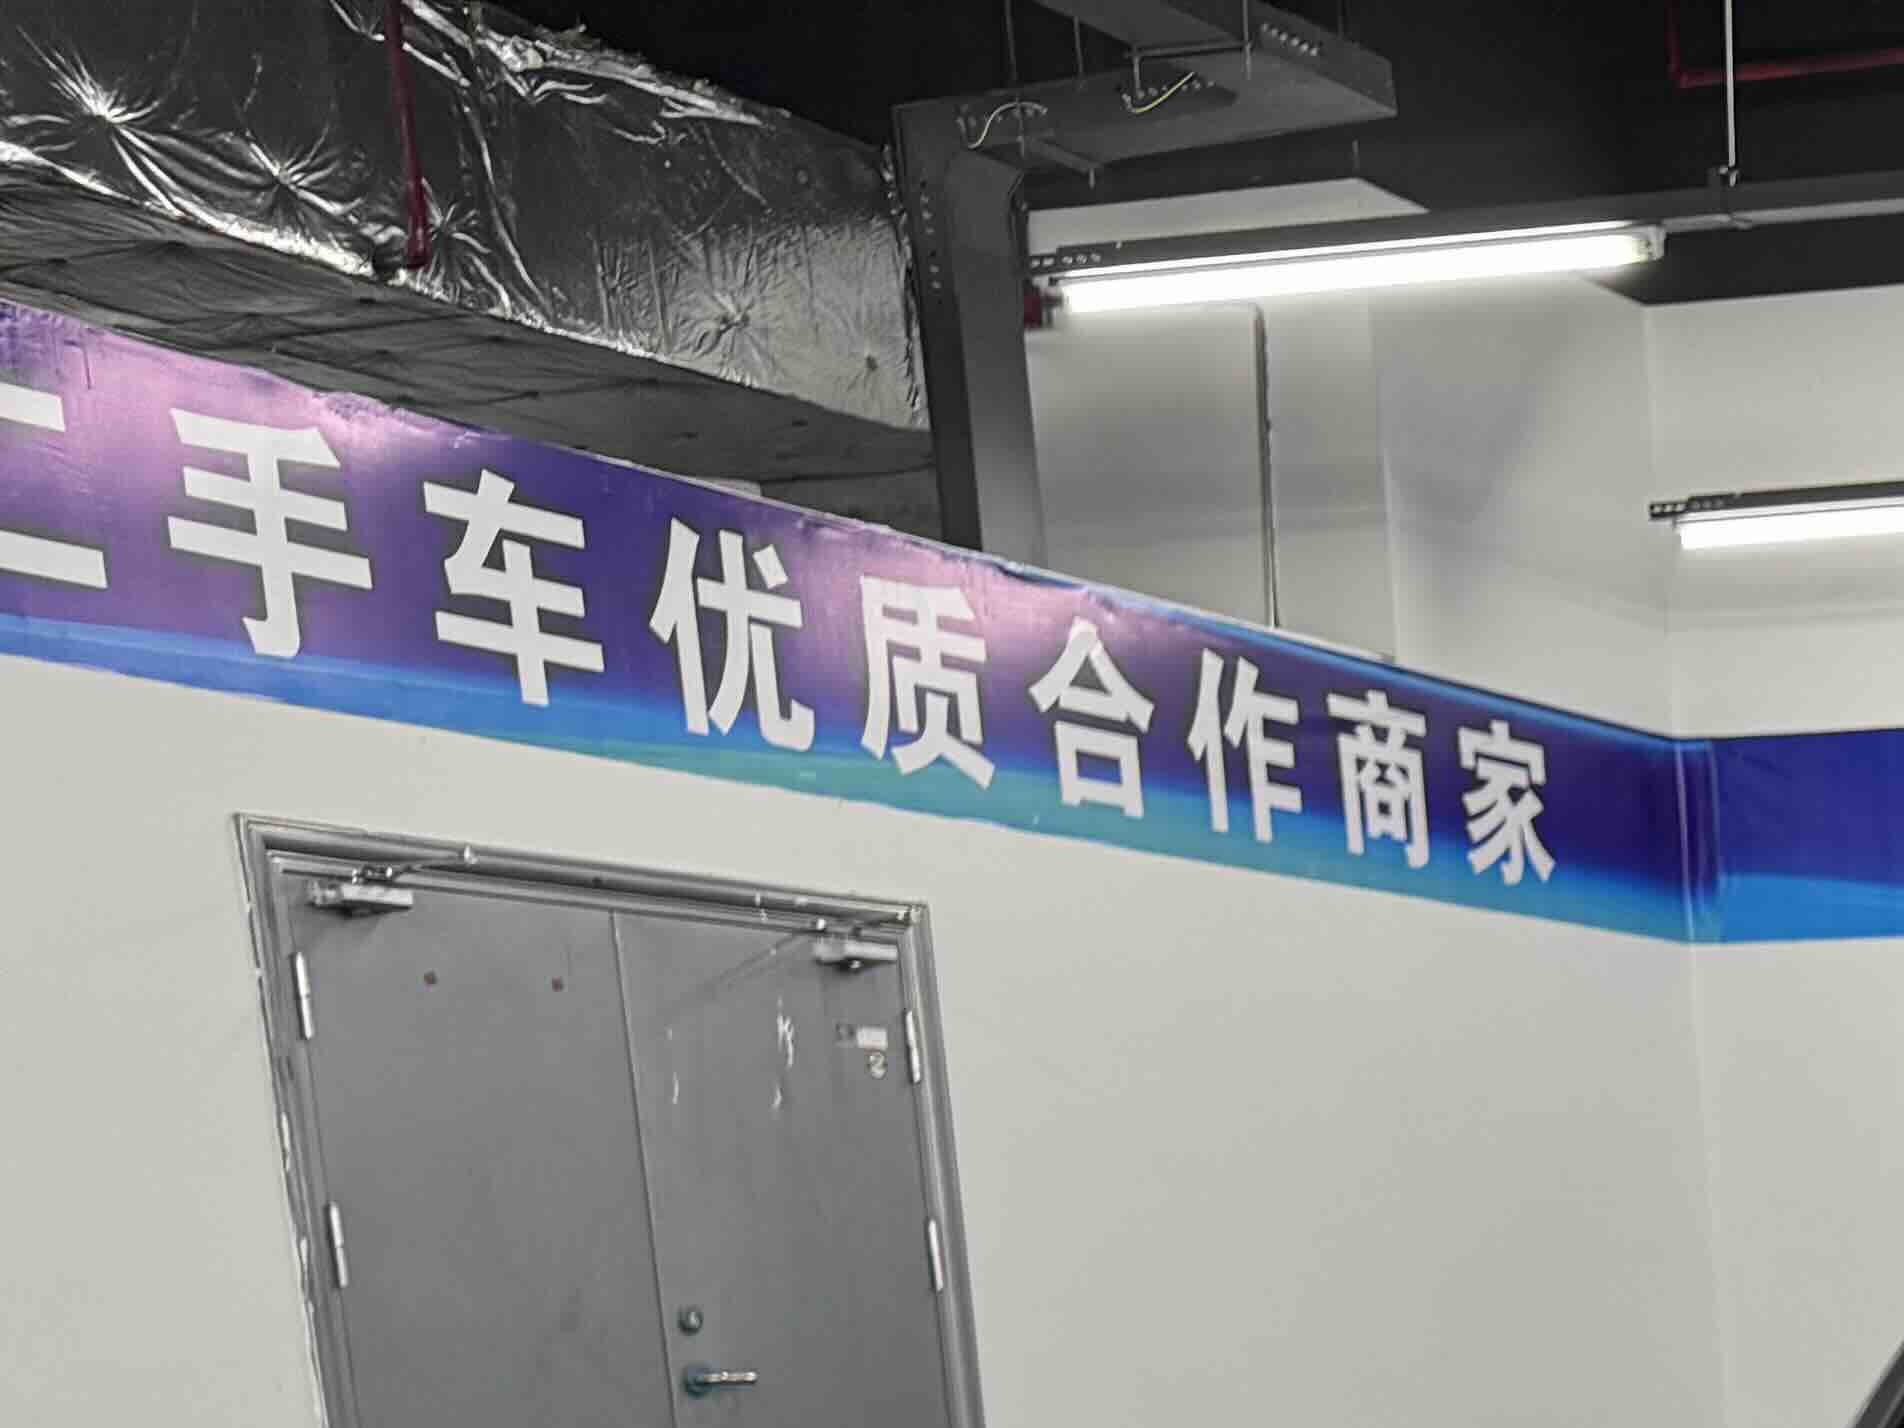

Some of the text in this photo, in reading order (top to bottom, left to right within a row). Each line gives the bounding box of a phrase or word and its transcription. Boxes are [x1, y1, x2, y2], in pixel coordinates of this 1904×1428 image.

[0, 385, 1556, 886] 二手车优质合作商家
